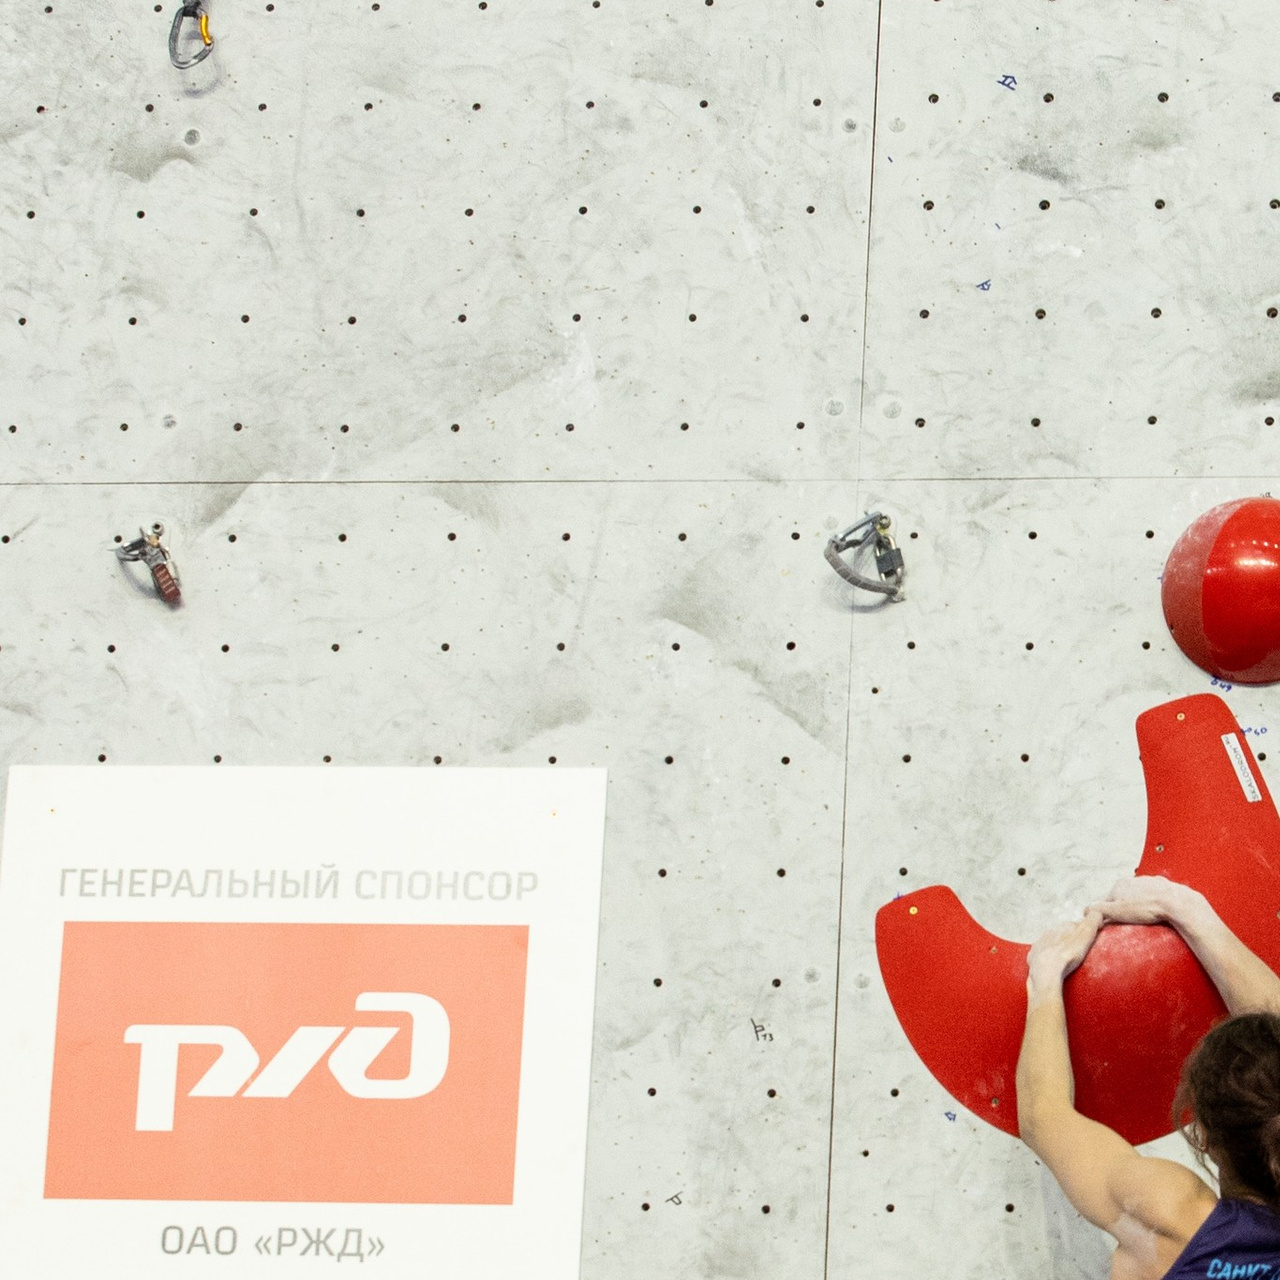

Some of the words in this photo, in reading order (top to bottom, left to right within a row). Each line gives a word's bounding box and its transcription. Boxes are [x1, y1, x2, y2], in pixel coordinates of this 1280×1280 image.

[58, 863, 340, 900] ГЕНЕРАЛЬНЫЙ
[354, 869, 539, 901] СПОНСОР
[160, 1225, 238, 1255] ОАО
[254, 1227, 386, 1263] «РЖД»
